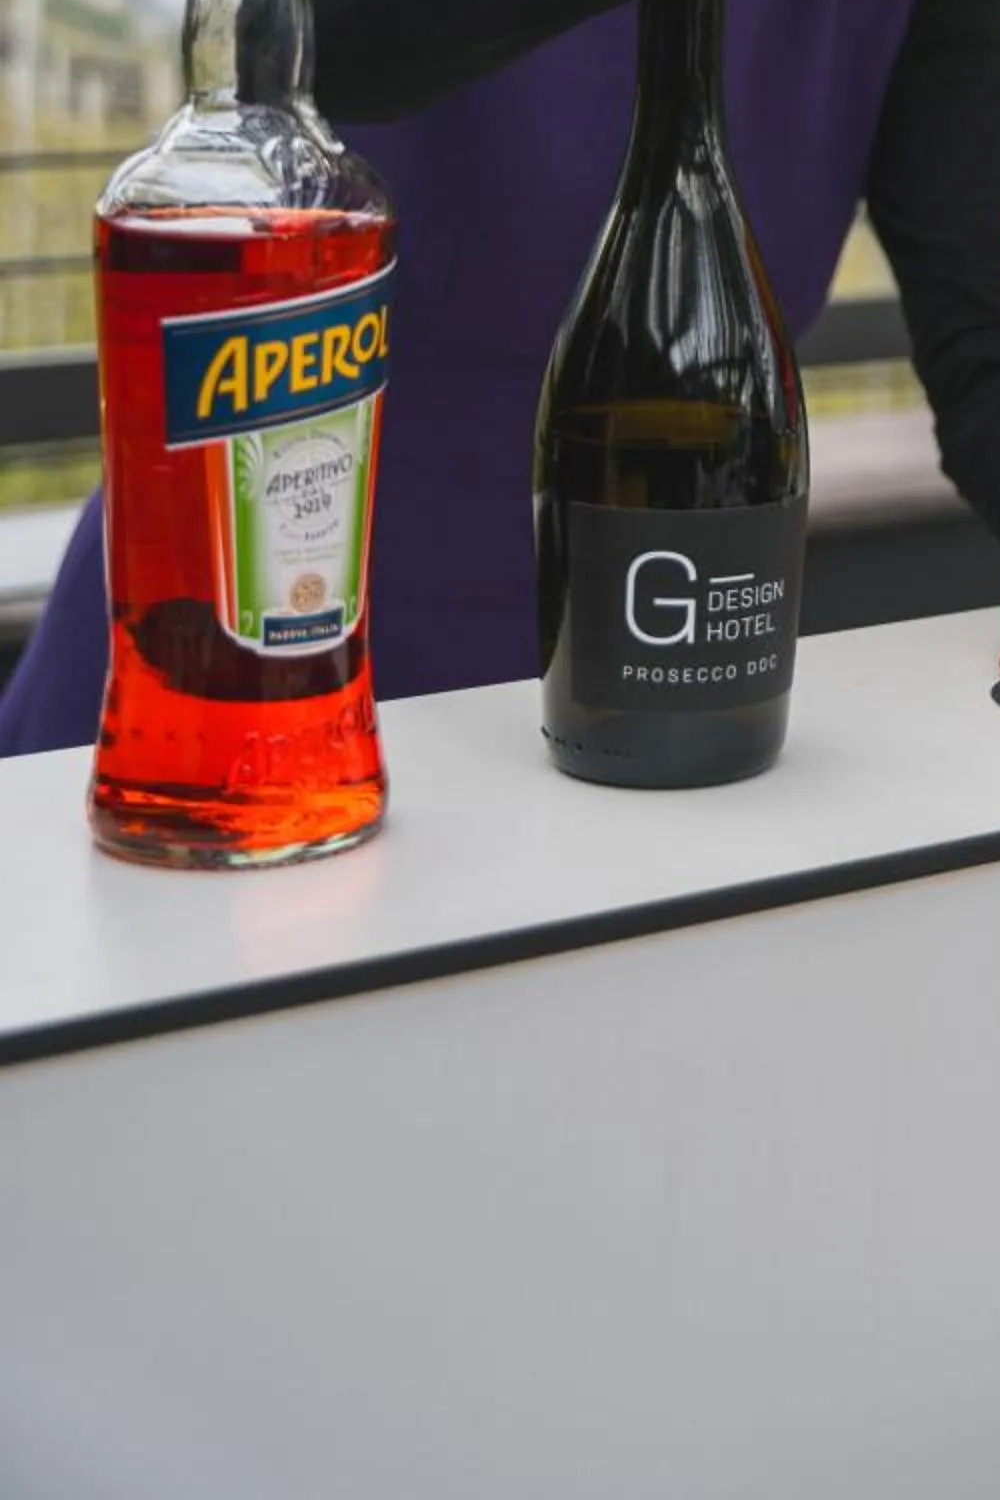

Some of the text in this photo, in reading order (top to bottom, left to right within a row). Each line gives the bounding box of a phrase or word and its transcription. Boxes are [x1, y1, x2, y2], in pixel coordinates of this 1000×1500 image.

[196, 304, 388, 419] APEROL
[266, 453, 353, 497] APERITIVO
[625, 550, 697, 646] G
[707, 578, 785, 612] DESIGN
[706, 611, 776, 643] HOTEL
[623, 653, 779, 684] PROSECCO DOC
